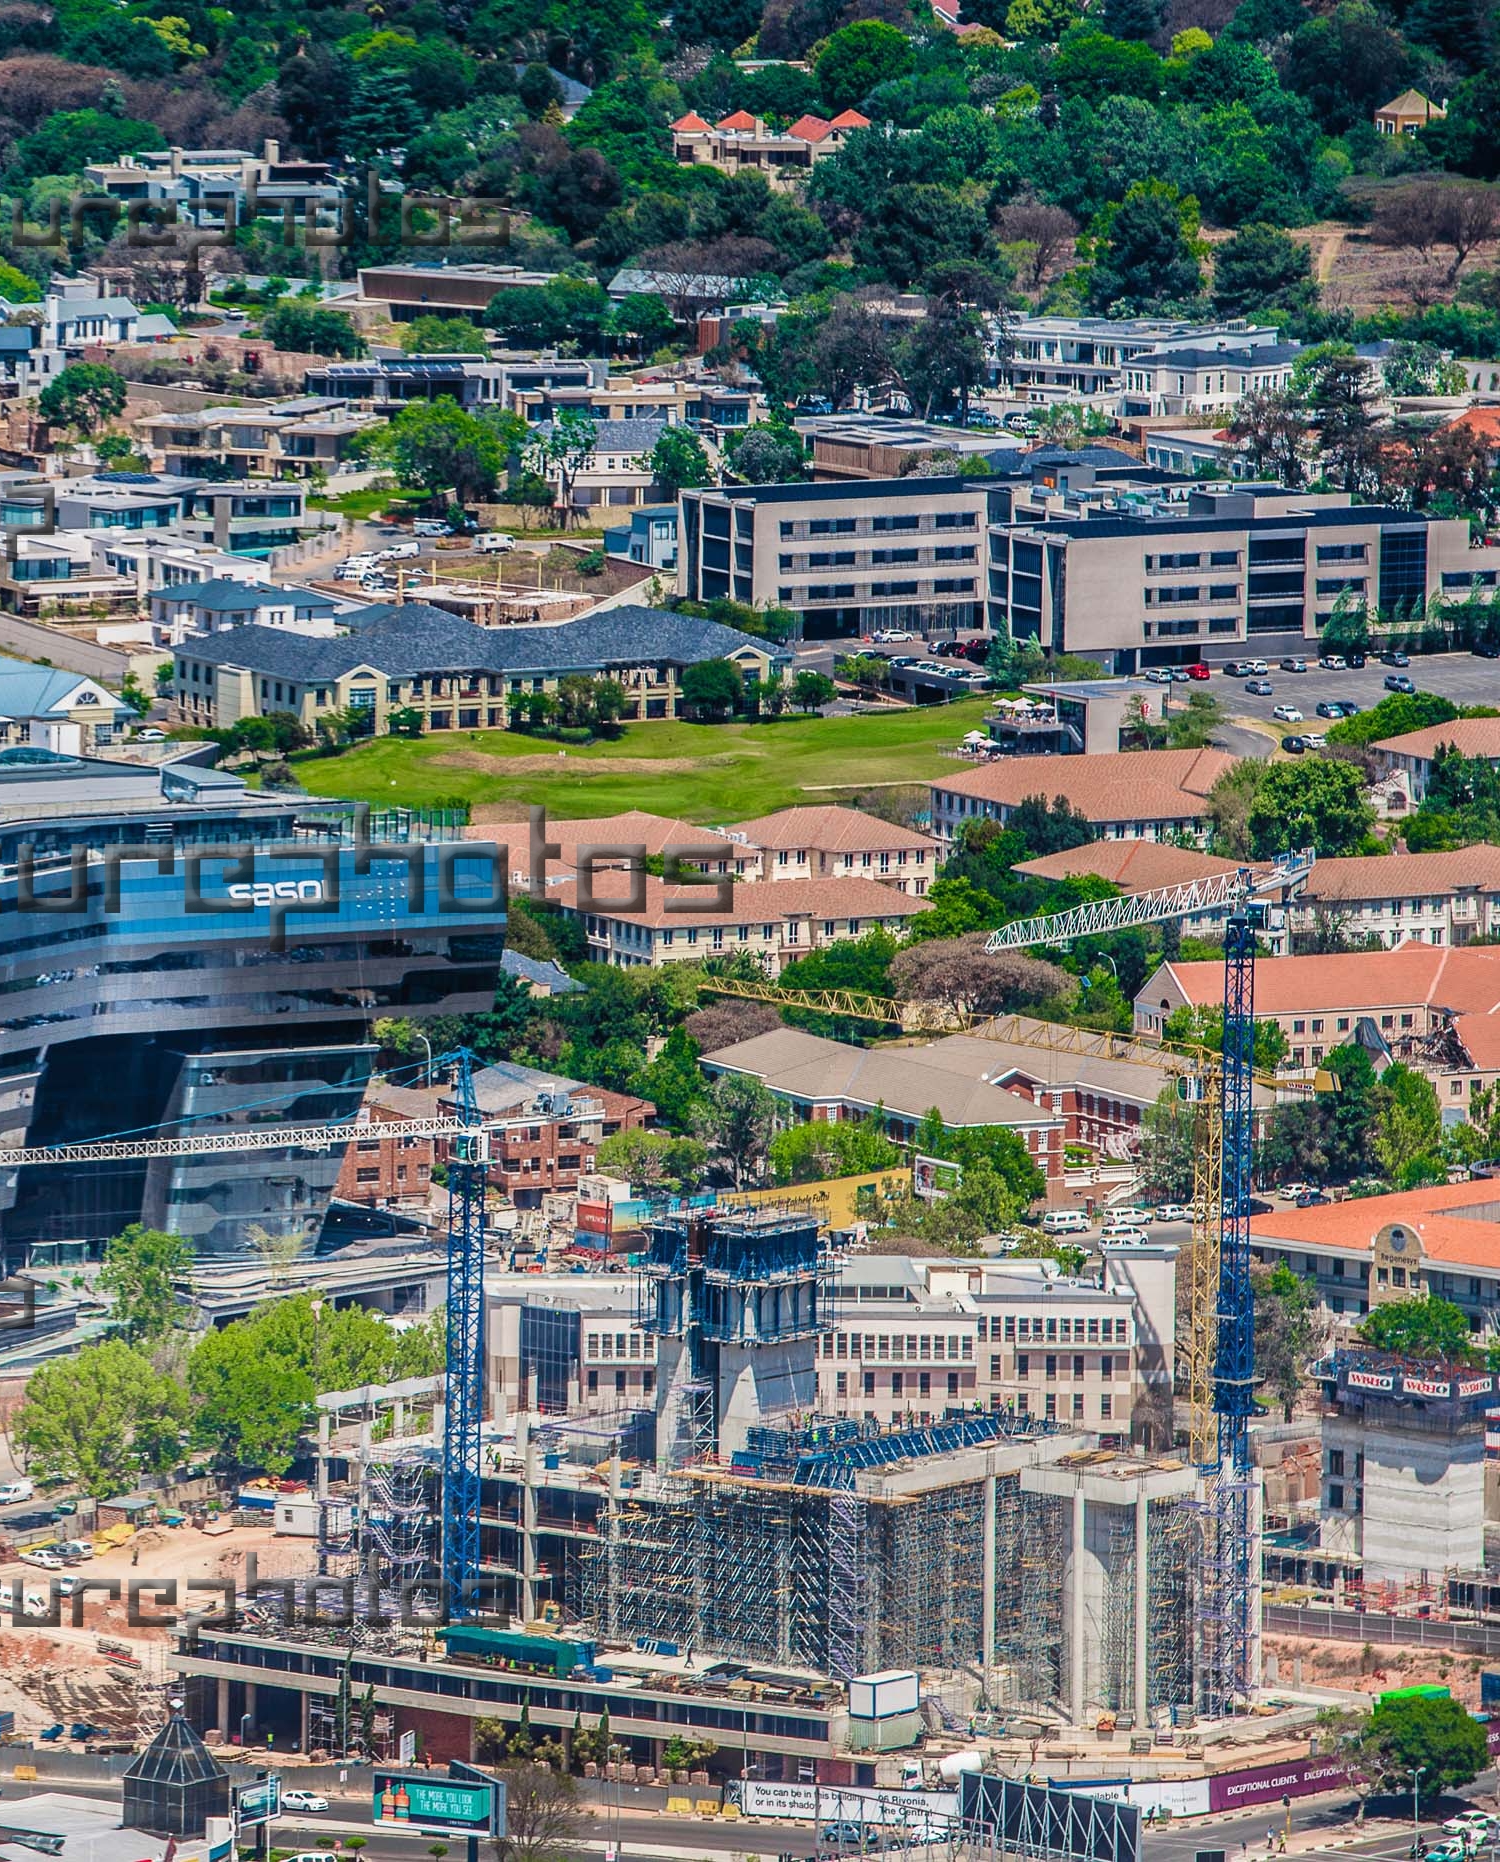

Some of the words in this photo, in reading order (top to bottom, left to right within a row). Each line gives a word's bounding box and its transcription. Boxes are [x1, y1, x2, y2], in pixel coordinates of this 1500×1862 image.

[1350, 1373, 1391, 1388] WBHO
[1406, 1380, 1448, 1395] WBHO
[755, 1785, 771, 1796] You
[773, 1788, 789, 1797] can
[790, 1789, 802, 1798] be
[803, 1791, 812, 1799] in
[1227, 1780, 1271, 1796] EXCEPTIONAL
[416, 1788, 427, 1800] THE
[427, 1789, 445, 1802] MORE
[445, 1792, 458, 1804] YOU
[458, 1792, 474, 1804] LOOK
[755, 1799, 764, 1807] or
[766, 1799, 774, 1808] in
[776, 1799, 787, 1808] its
[420, 1799, 431, 1811] THE
[432, 1801, 448, 1813] MORE
[450, 1803, 462, 1814] YOU
